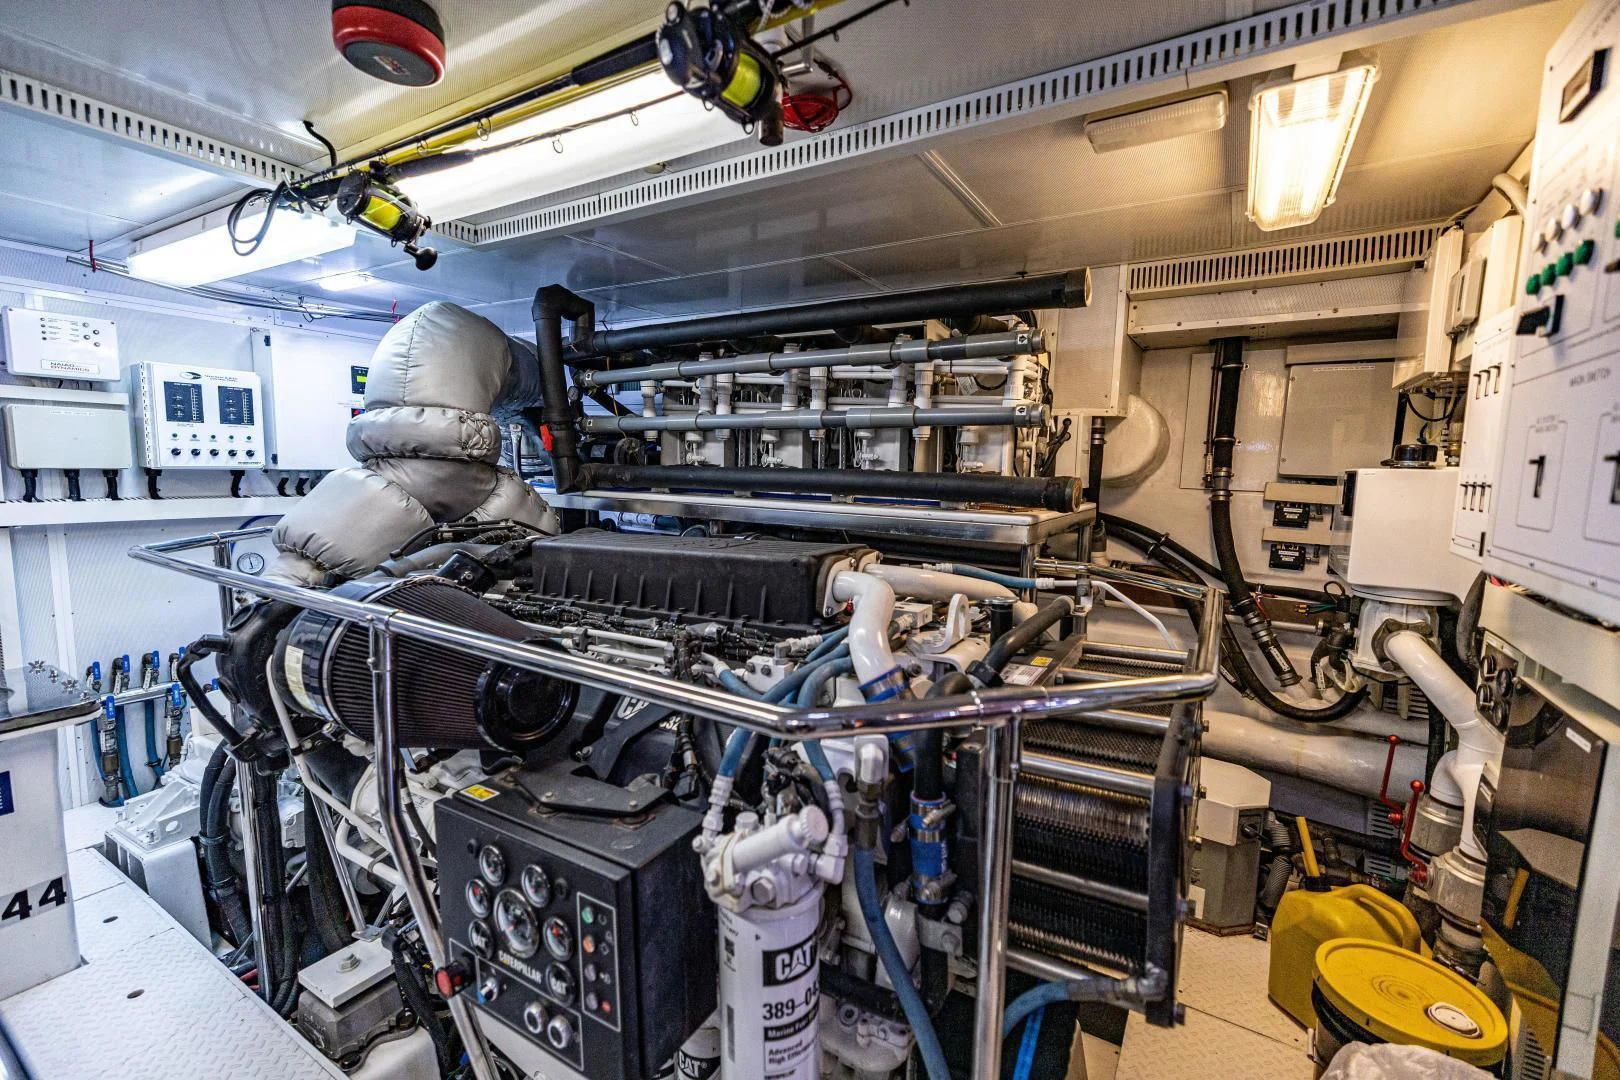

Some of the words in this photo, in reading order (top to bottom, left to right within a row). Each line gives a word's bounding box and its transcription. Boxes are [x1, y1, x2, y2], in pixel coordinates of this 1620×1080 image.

[498, 949, 542, 984] CATERPILLAR
[775, 942, 813, 981] CAT
[768, 1039, 803, 1057] Advanced
[679, 1050, 701, 1078] CAT
